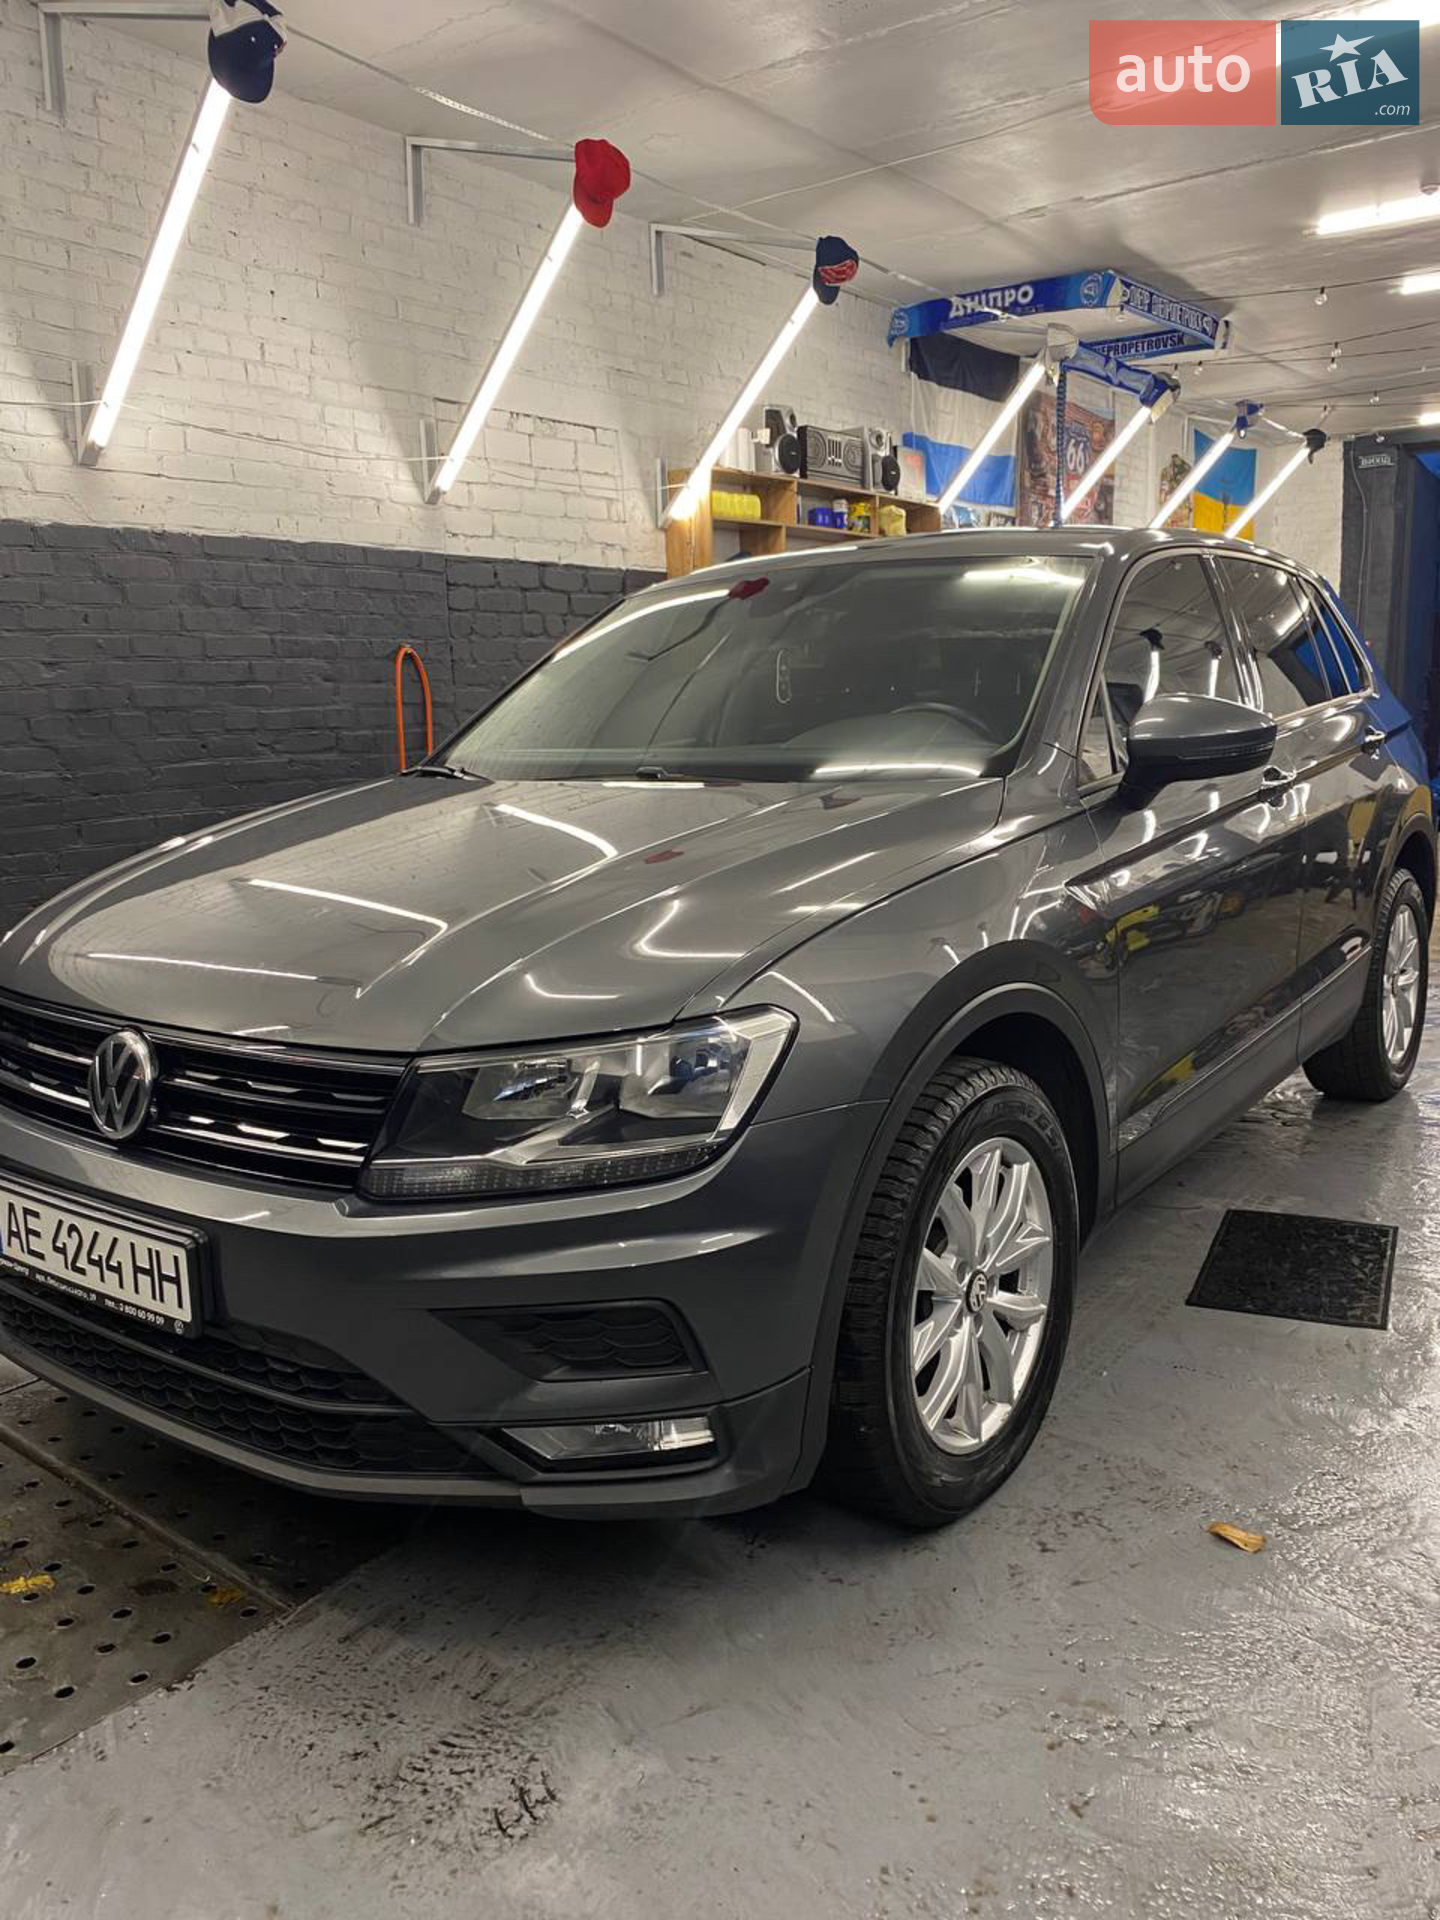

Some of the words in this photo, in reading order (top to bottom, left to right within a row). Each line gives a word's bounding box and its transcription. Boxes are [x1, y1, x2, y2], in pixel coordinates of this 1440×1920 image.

[949, 284, 1034, 319] ДНІПРО
[1066, 438, 1085, 475] 66
[8, 1201, 45, 1261] AE
[52, 1218, 124, 1290] 4244
[130, 1241, 183, 1309] HH
